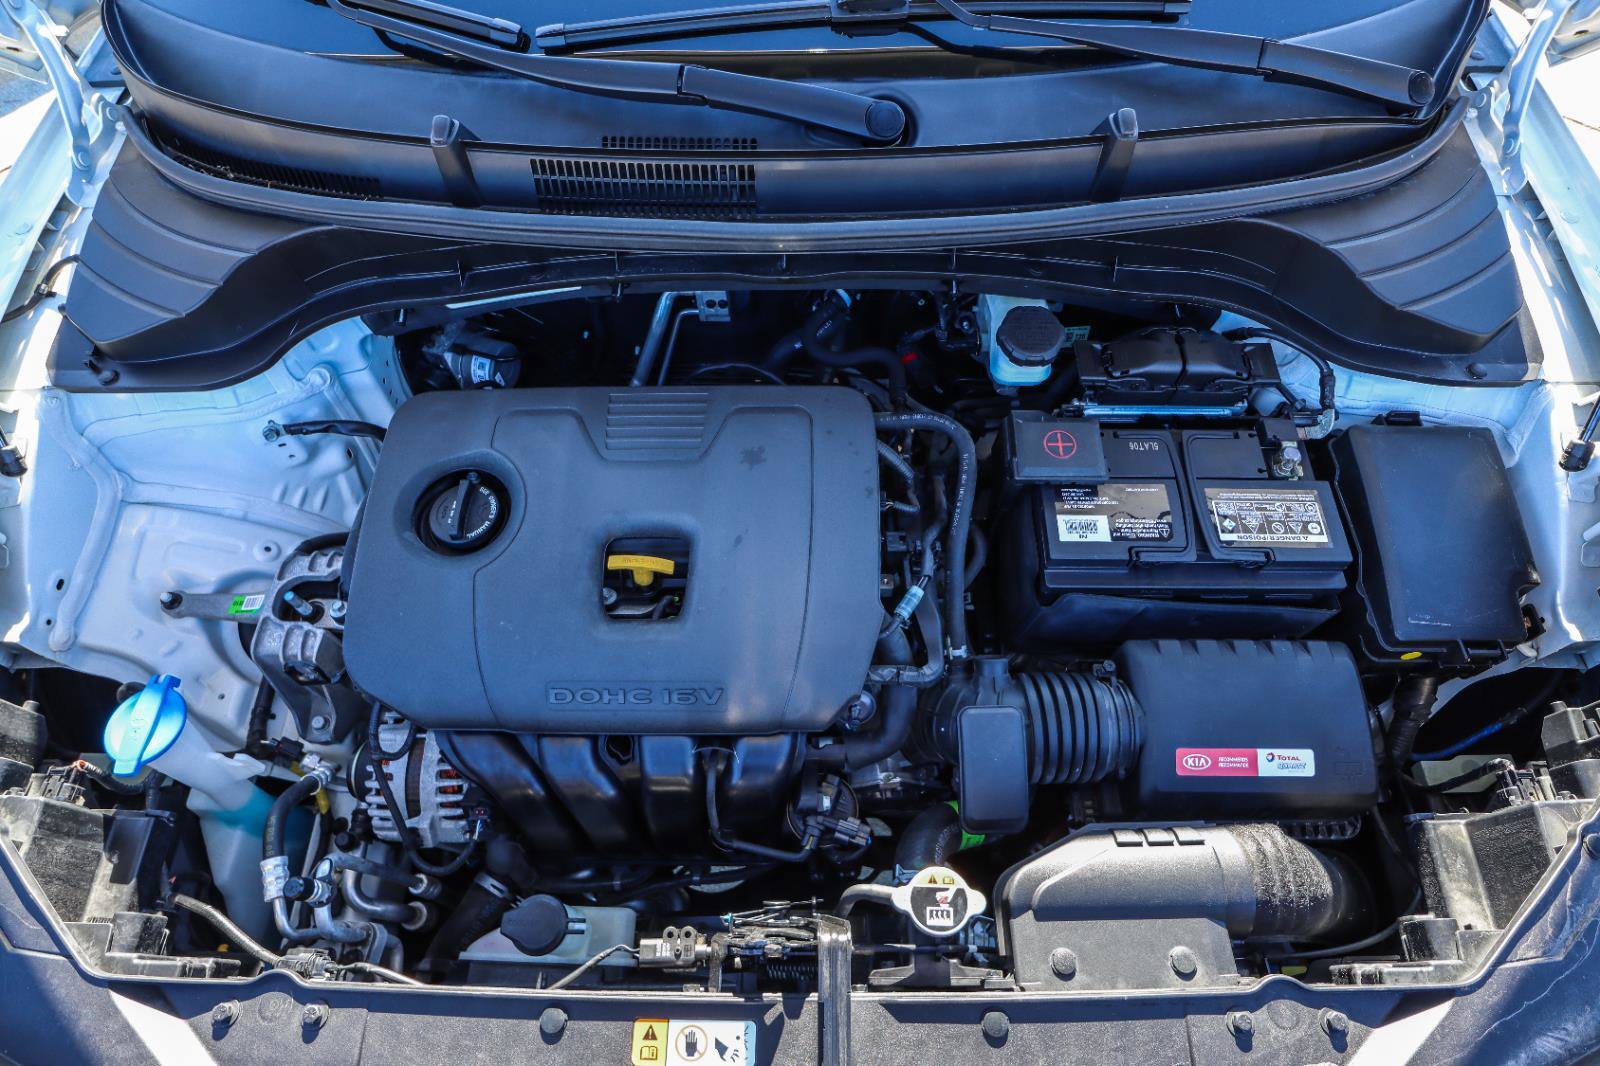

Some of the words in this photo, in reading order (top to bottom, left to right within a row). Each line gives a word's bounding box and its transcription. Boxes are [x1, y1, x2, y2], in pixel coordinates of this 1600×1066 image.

[549, 688, 653, 705] DOHC
[663, 688, 725, 706] 16V
[1187, 757, 1206, 767] KIA
